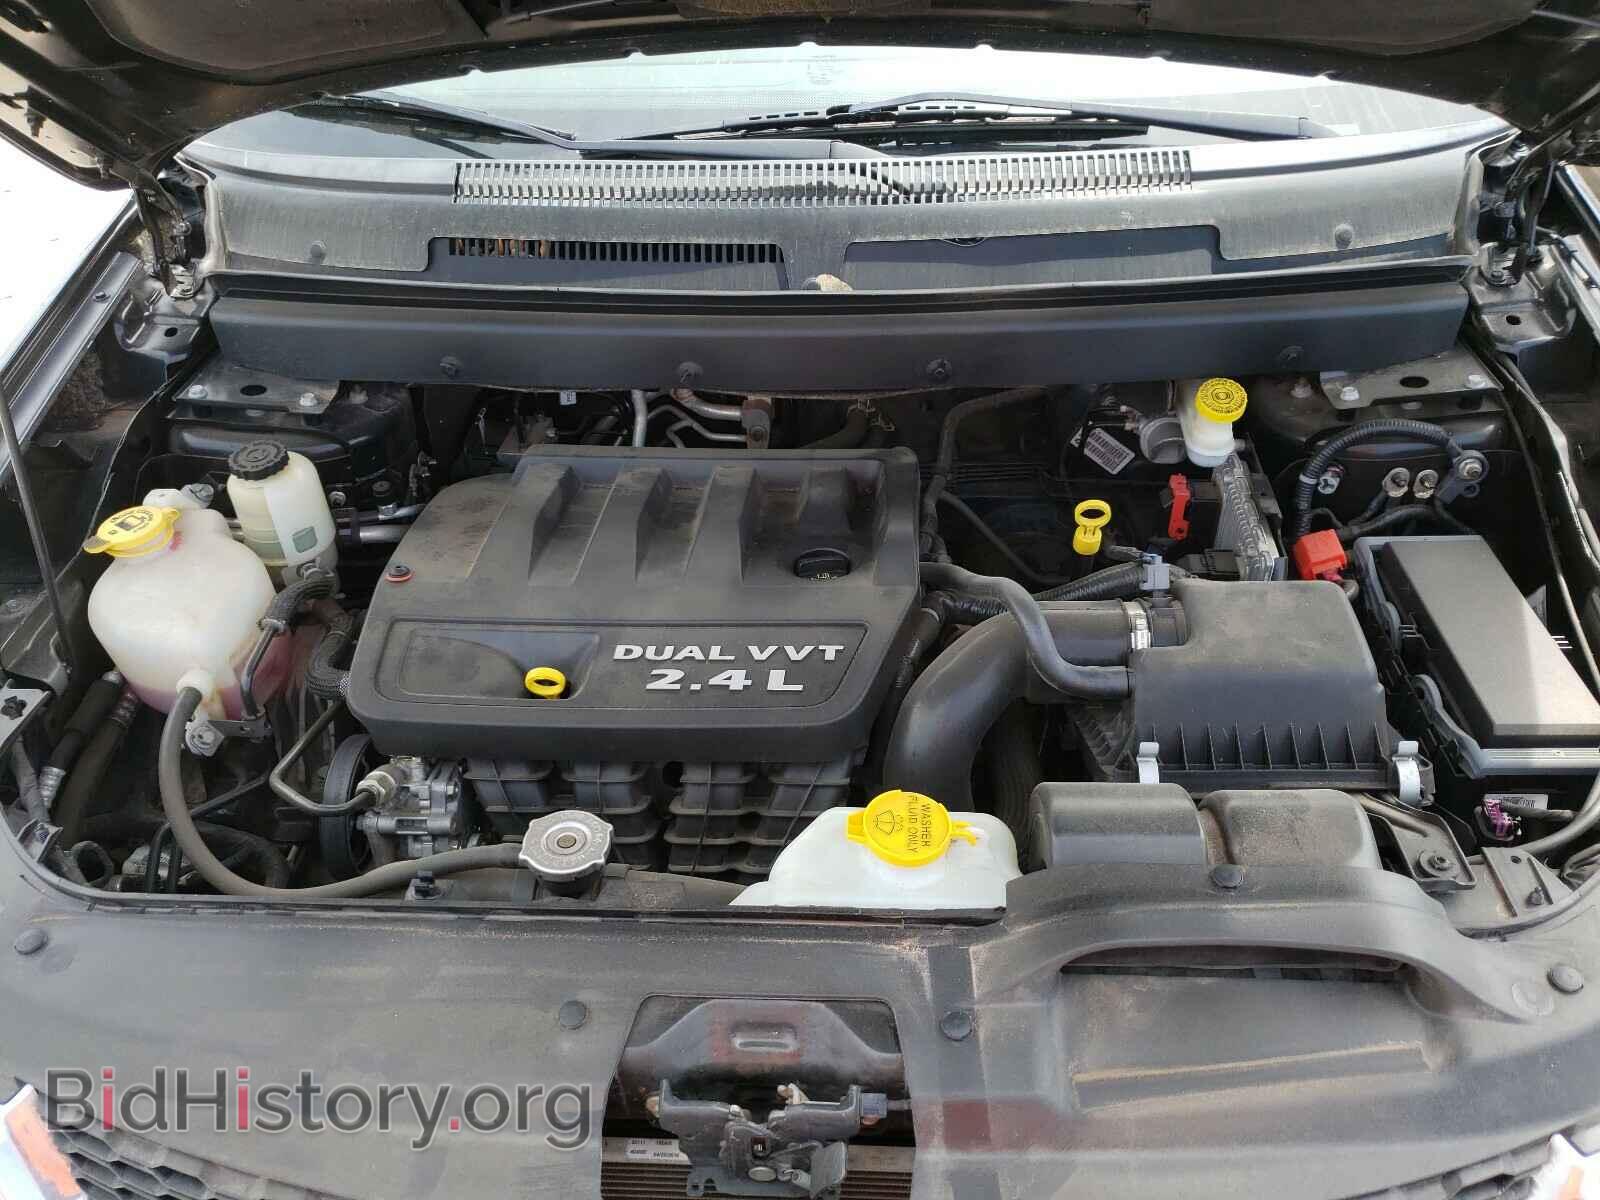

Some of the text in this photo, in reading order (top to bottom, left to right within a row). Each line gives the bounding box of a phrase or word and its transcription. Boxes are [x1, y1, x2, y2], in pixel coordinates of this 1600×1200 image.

[613, 645, 844, 661] DUAL VVT
[646, 668, 804, 691] 2.4 L
[907, 795, 918, 853] FLUID ONLY
[921, 803, 932, 847] WASHER
